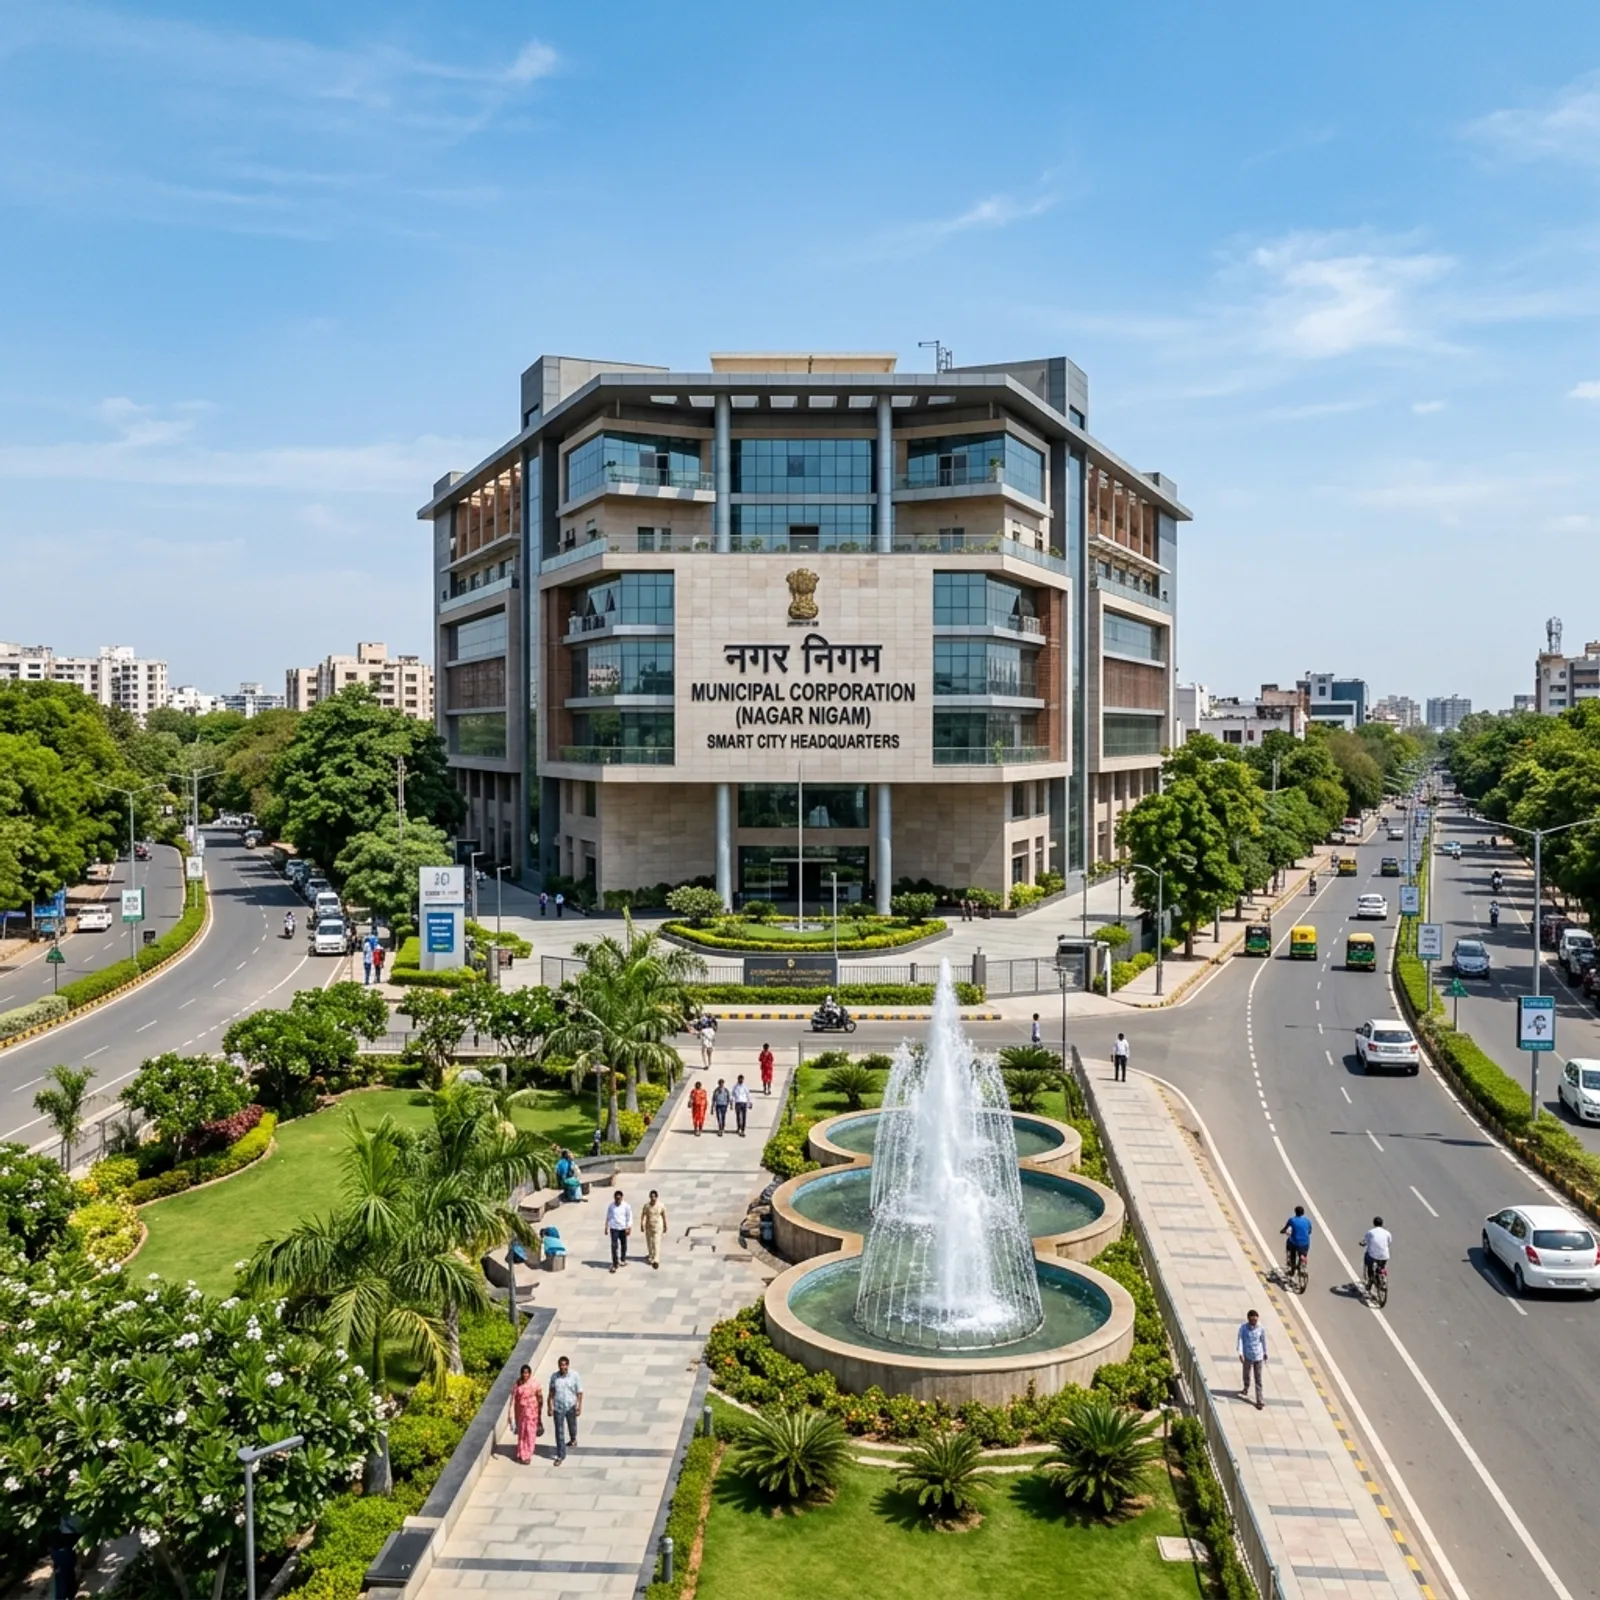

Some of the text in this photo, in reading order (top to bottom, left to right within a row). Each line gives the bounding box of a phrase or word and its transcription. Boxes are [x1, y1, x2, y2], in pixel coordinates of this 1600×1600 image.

[724, 633, 883, 674] नगर निगम
[691, 682, 916, 702] MUNICIPAL CORPORATION
[736, 706, 871, 729] (NAGAR NIGAM)
[707, 734, 900, 750] SMART CITY HEADQUARTERS
